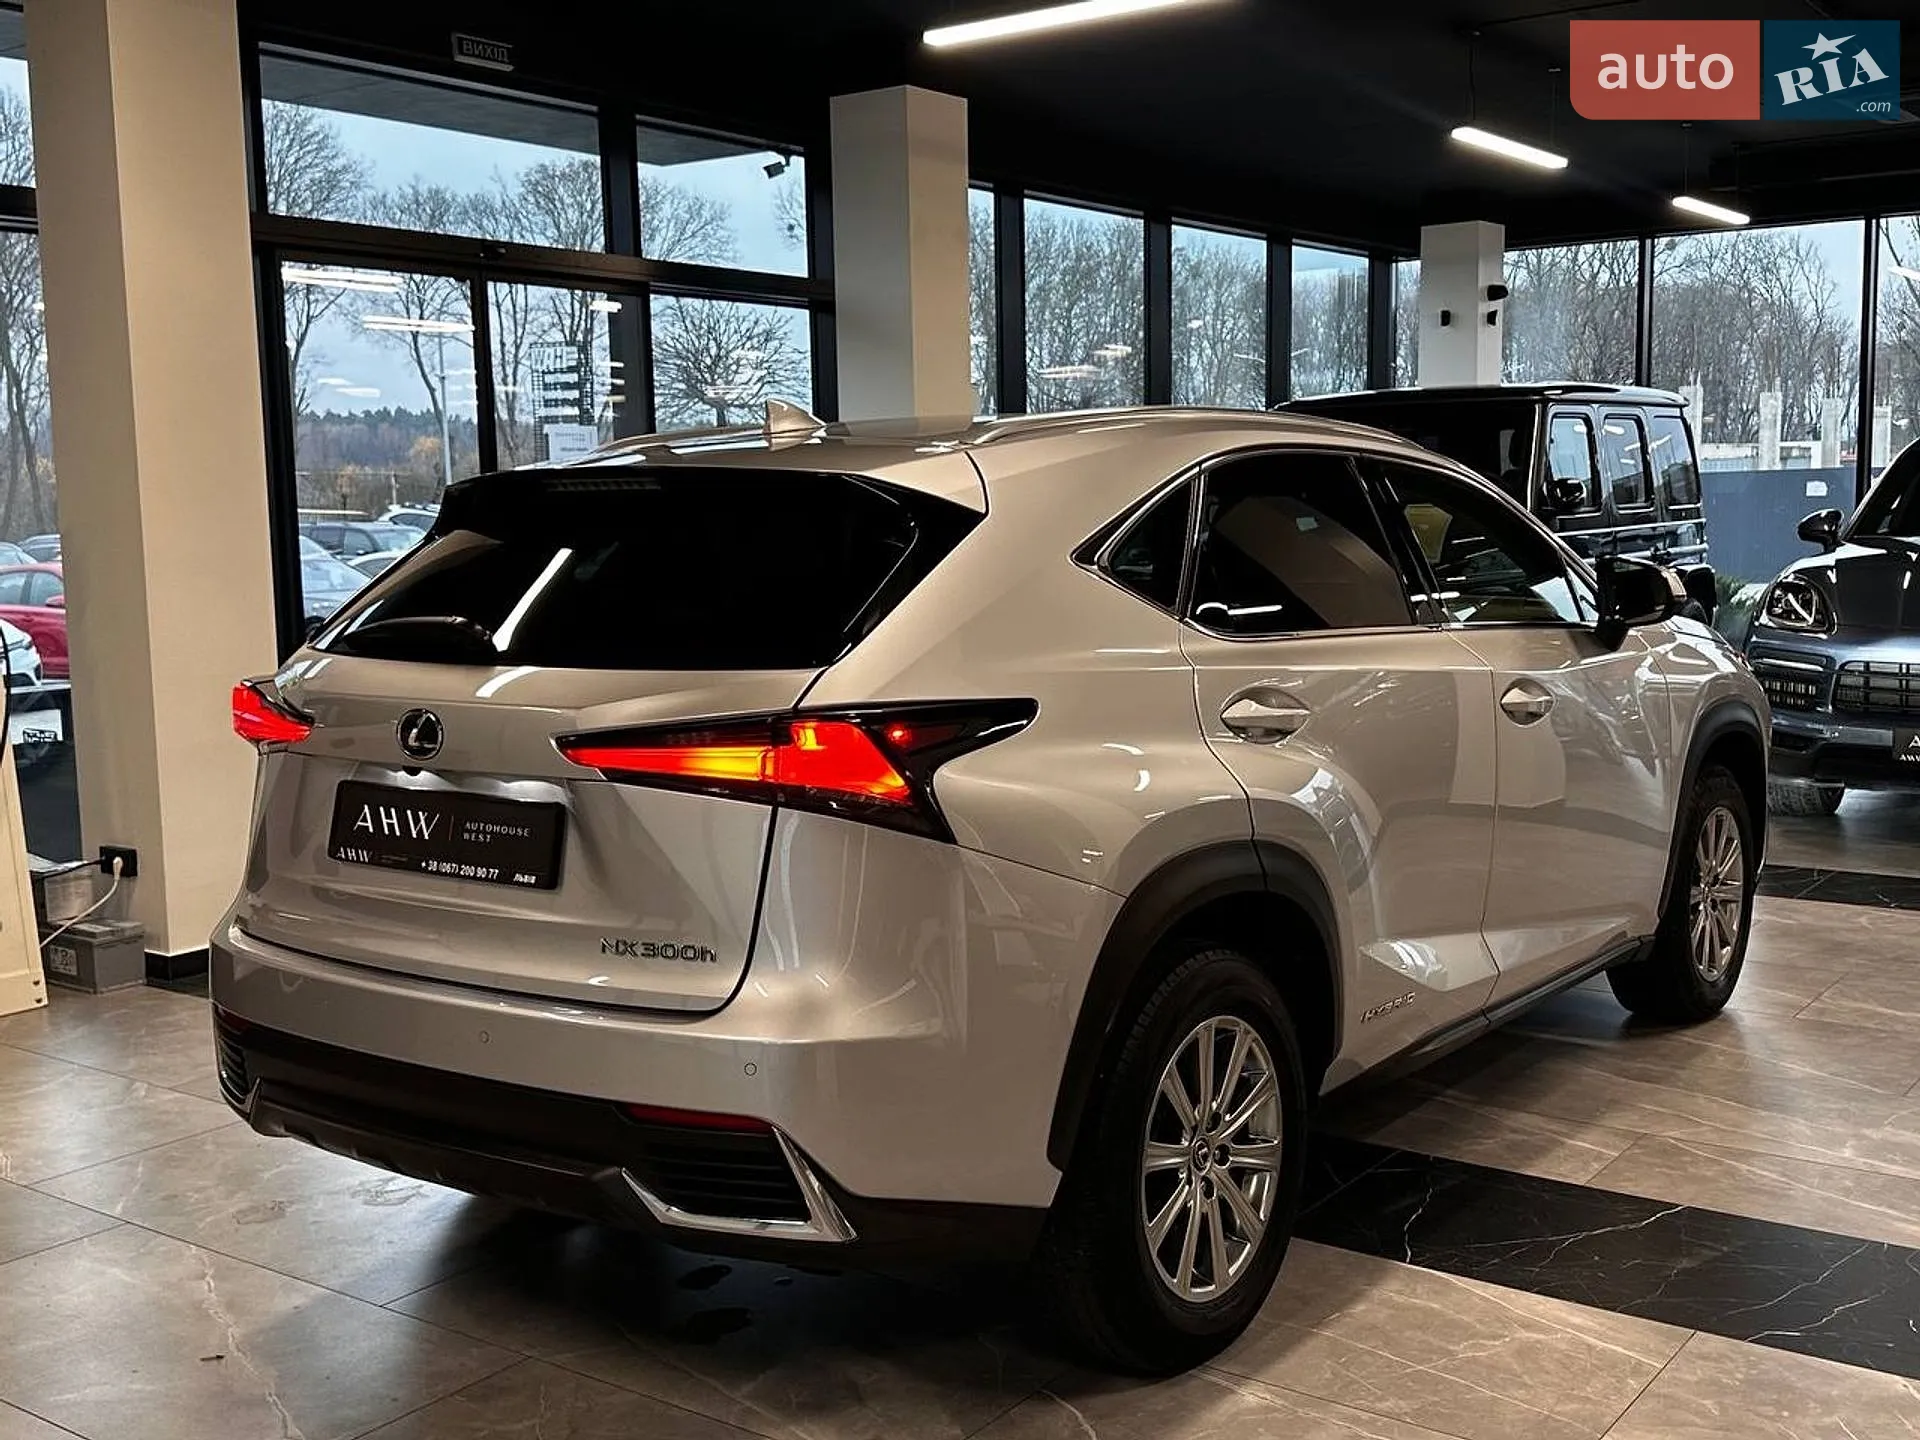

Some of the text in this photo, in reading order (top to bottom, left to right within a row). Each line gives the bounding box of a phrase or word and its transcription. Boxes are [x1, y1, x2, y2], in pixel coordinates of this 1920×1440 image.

[463, 40, 509, 63] ВИХІД
[353, 804, 440, 840] AHW
[464, 821, 530, 837] AUTOHOUSE
[463, 832, 491, 843] WEST
[336, 846, 373, 863] AHW
[428, 860, 438, 871] 38
[460, 864, 475, 877] 200
[476, 866, 487, 879] 90
[488, 867, 499, 880] 77
[600, 938, 718, 962] NX300h
